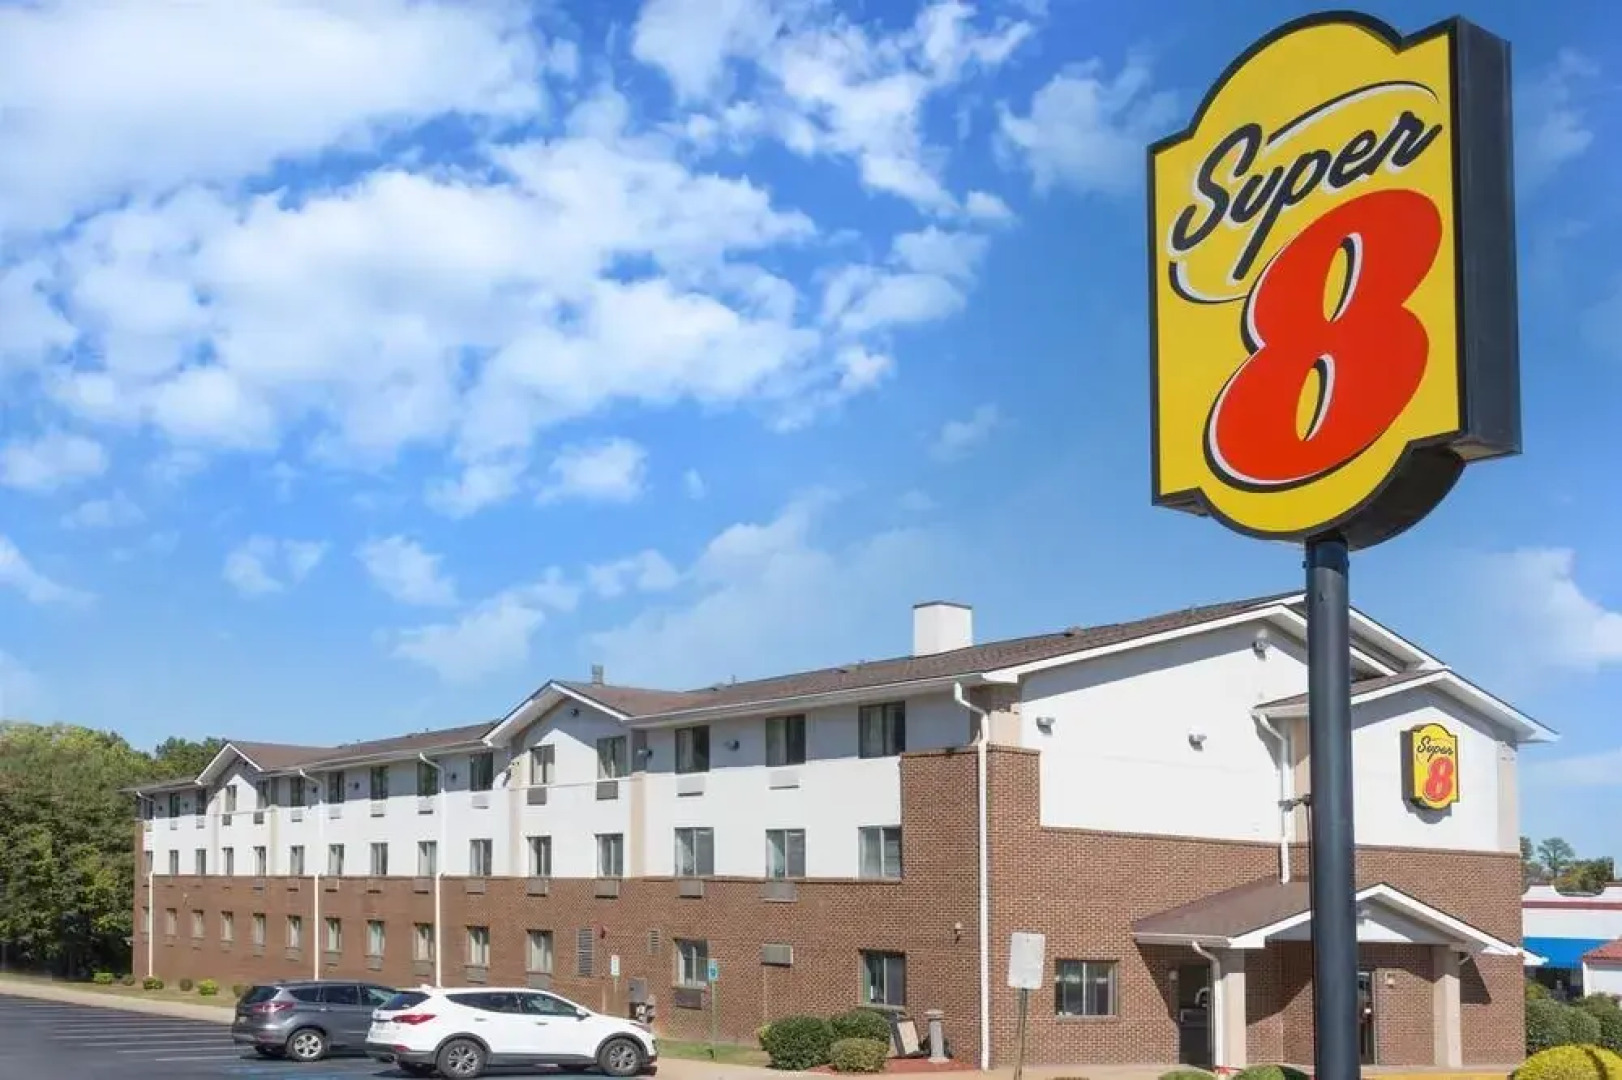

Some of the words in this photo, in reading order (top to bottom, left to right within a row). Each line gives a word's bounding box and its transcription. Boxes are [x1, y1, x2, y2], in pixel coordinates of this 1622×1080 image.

[1170, 110, 1443, 281] Super
[1202, 188, 1443, 493] 8
[1417, 735, 1454, 763] Super
[1424, 756, 1454, 801] 8
